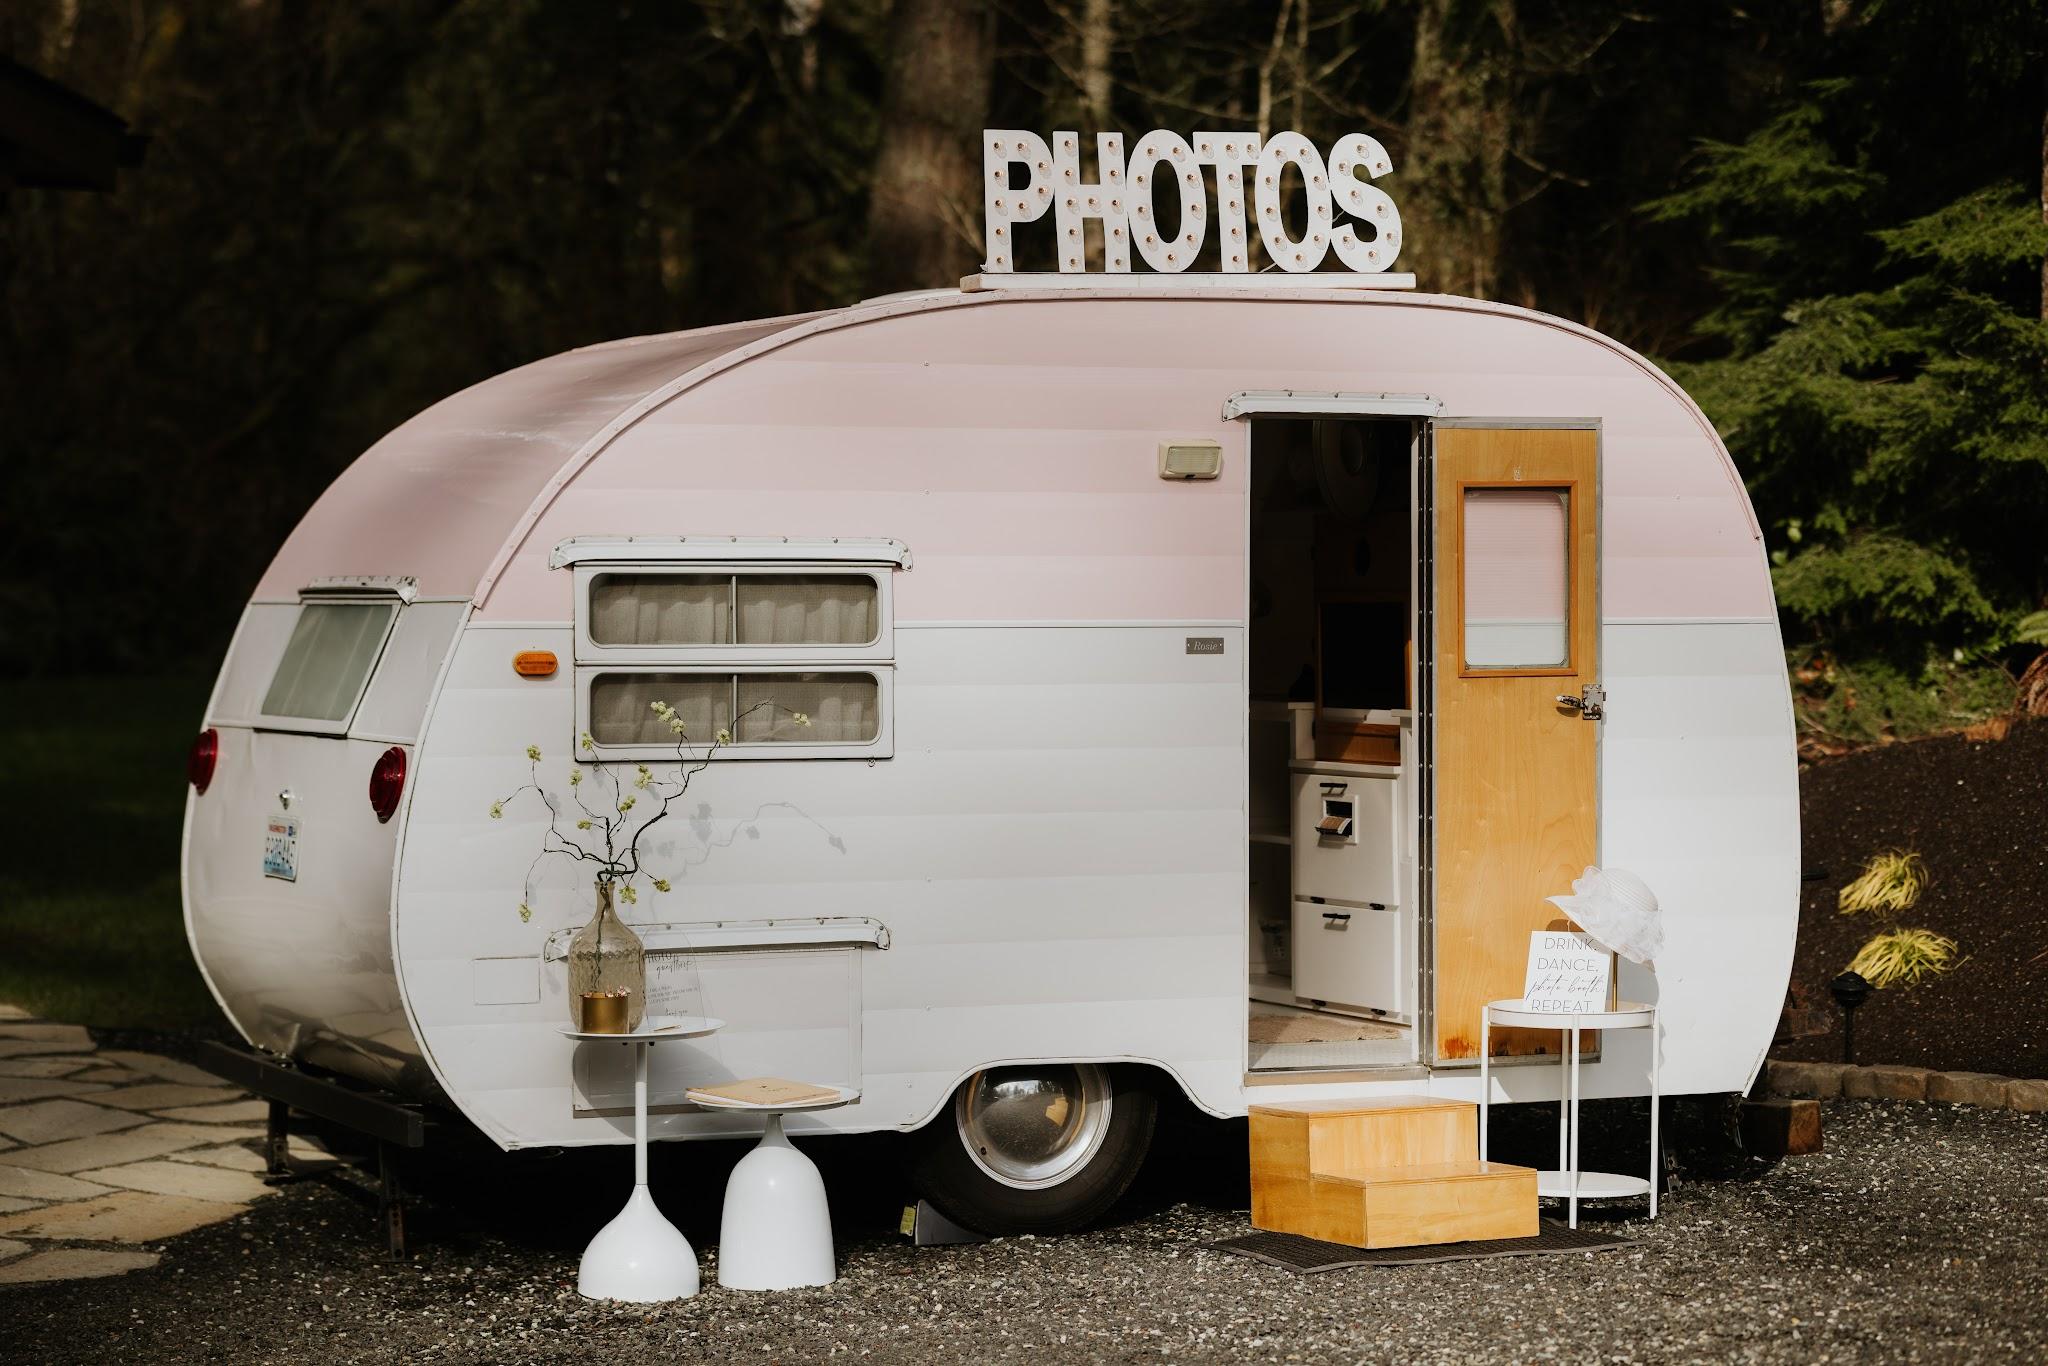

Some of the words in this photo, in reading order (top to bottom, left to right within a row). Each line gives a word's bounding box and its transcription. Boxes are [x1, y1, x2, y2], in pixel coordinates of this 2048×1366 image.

[983, 129, 1403, 273] PHOTOS
[1193, 640, 1218, 651] Rosie
[1544, 937, 1597, 951] DRINK.
[1537, 957, 1599, 972] DANCE.
[1525, 974, 1568, 1000] photo
[1531, 999, 1595, 1013] REPEAT.
